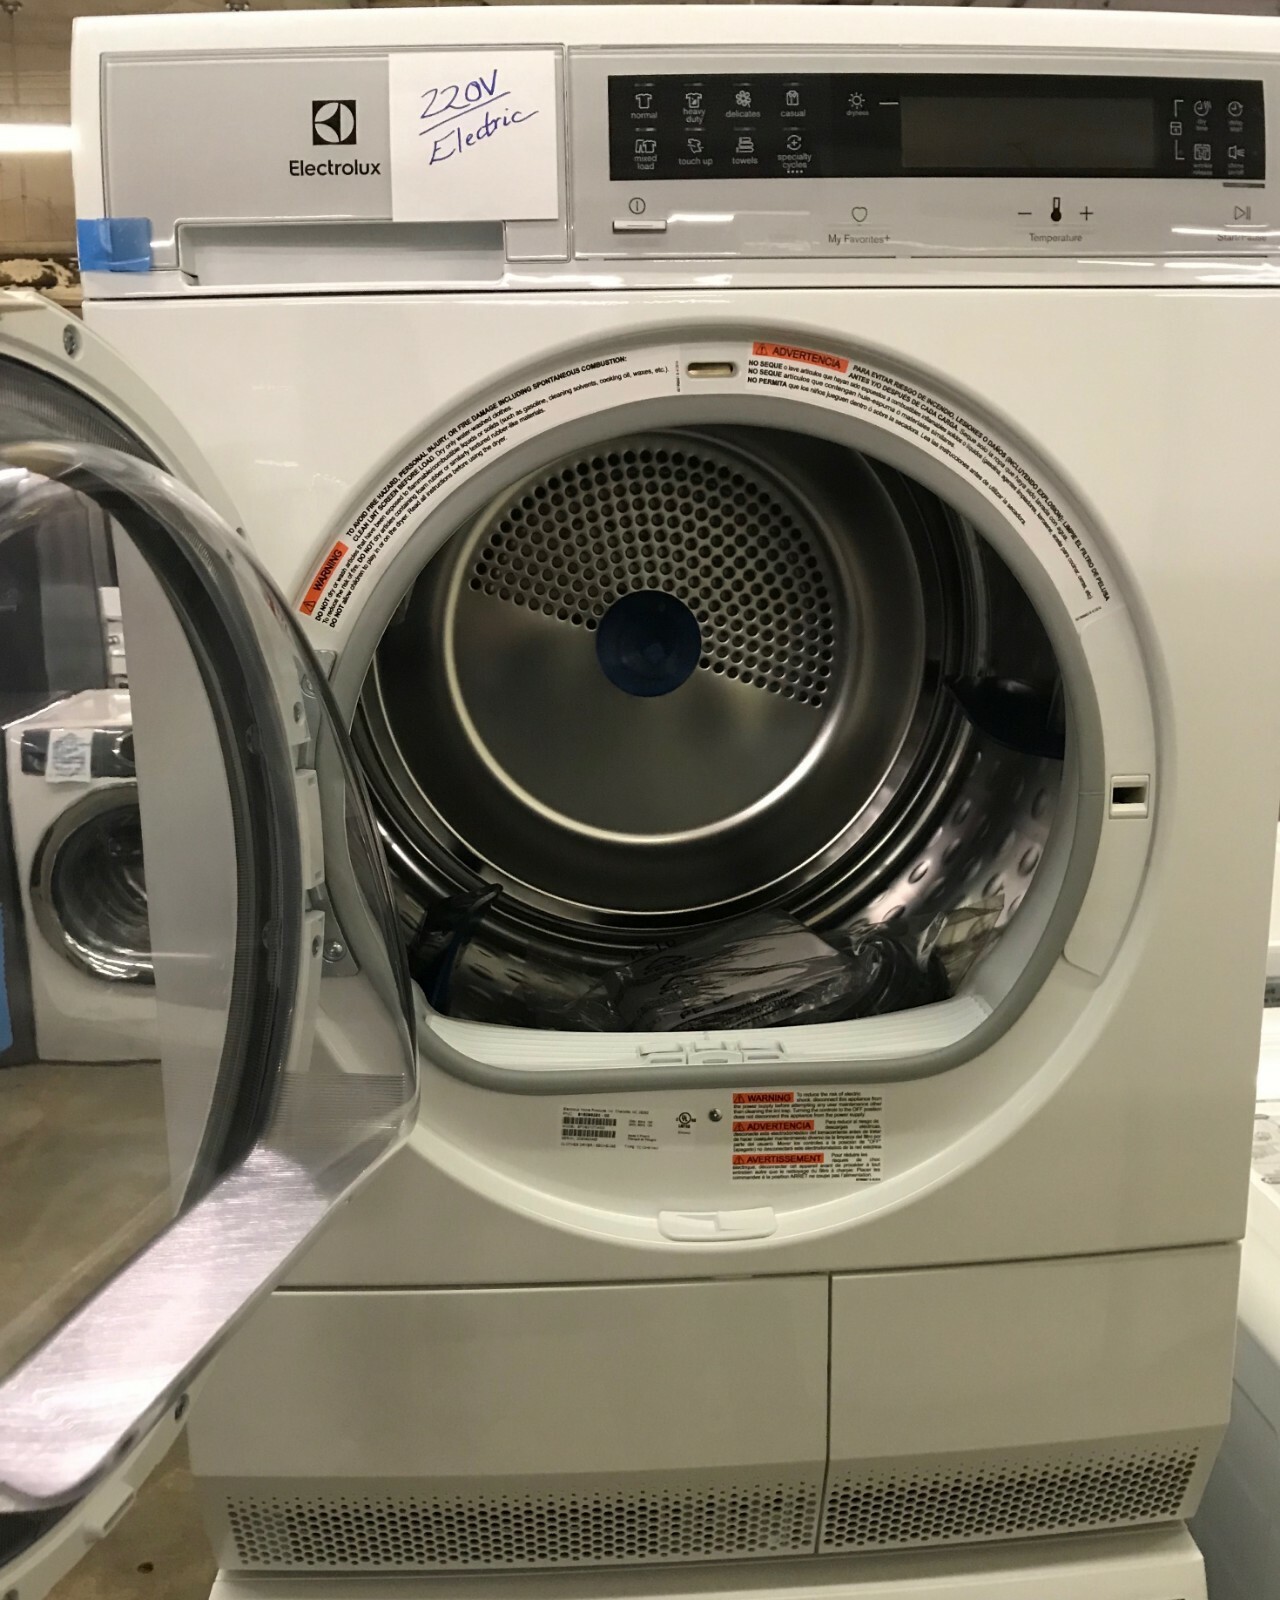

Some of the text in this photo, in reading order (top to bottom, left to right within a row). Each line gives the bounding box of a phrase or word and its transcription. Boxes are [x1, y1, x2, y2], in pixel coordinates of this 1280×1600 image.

[420, 69, 498, 119] 220V
[630, 111, 658, 119] normal
[683, 108, 706, 117] heavy
[725, 109, 761, 119] delicates
[780, 109, 806, 117] casual
[686, 115, 704, 125] duty
[429, 108, 538, 165] Electric
[634, 154, 658, 163] mixed
[678, 157, 713, 167] touch up
[731, 157, 758, 165] towels
[777, 153, 812, 163] specialty
[289, 160, 381, 176] Electrolux
[637, 162, 655, 170] load
[782, 161, 808, 170] cycles
[828, 234, 841, 244] My
[1029, 232, 1083, 244] Temperature
[772, 346, 842, 369] ADVERTENCIA
[352, 510, 369, 530] AVOID
[365, 497, 380, 513] FIRE
[376, 477, 401, 500] HAZARD,
[398, 451, 429, 478] PERSONAL
[426, 434, 450, 454] INJURY,
[456, 418, 473, 431] FIRE
[470, 402, 499, 422] DAMAGE
[497, 385, 532, 407] INCLUDING
[852, 364, 871, 377] PARA
[870, 371, 894, 386] EVITAR
[893, 380, 918, 397] RIESGO
[955, 415, 984, 439] LESIONES
[1079, 547, 1095, 569] FILTRO
[1095, 576, 1110, 602] PELUSA
[352, 521, 370, 542] CLEAN
[366, 509, 380, 524] LINT
[377, 488, 400, 511] SCREEN
[396, 468, 420, 491] BEFORE
[434, 447, 446, 457] Dry
[445, 439, 457, 450] only
[312, 547, 344, 593] WARNING
[748, 1094, 791, 1102] WARNING
[747, 1122, 811, 1130] ADVERTENCIA
[747, 1154, 821, 1163] AVERTISSEMENT
